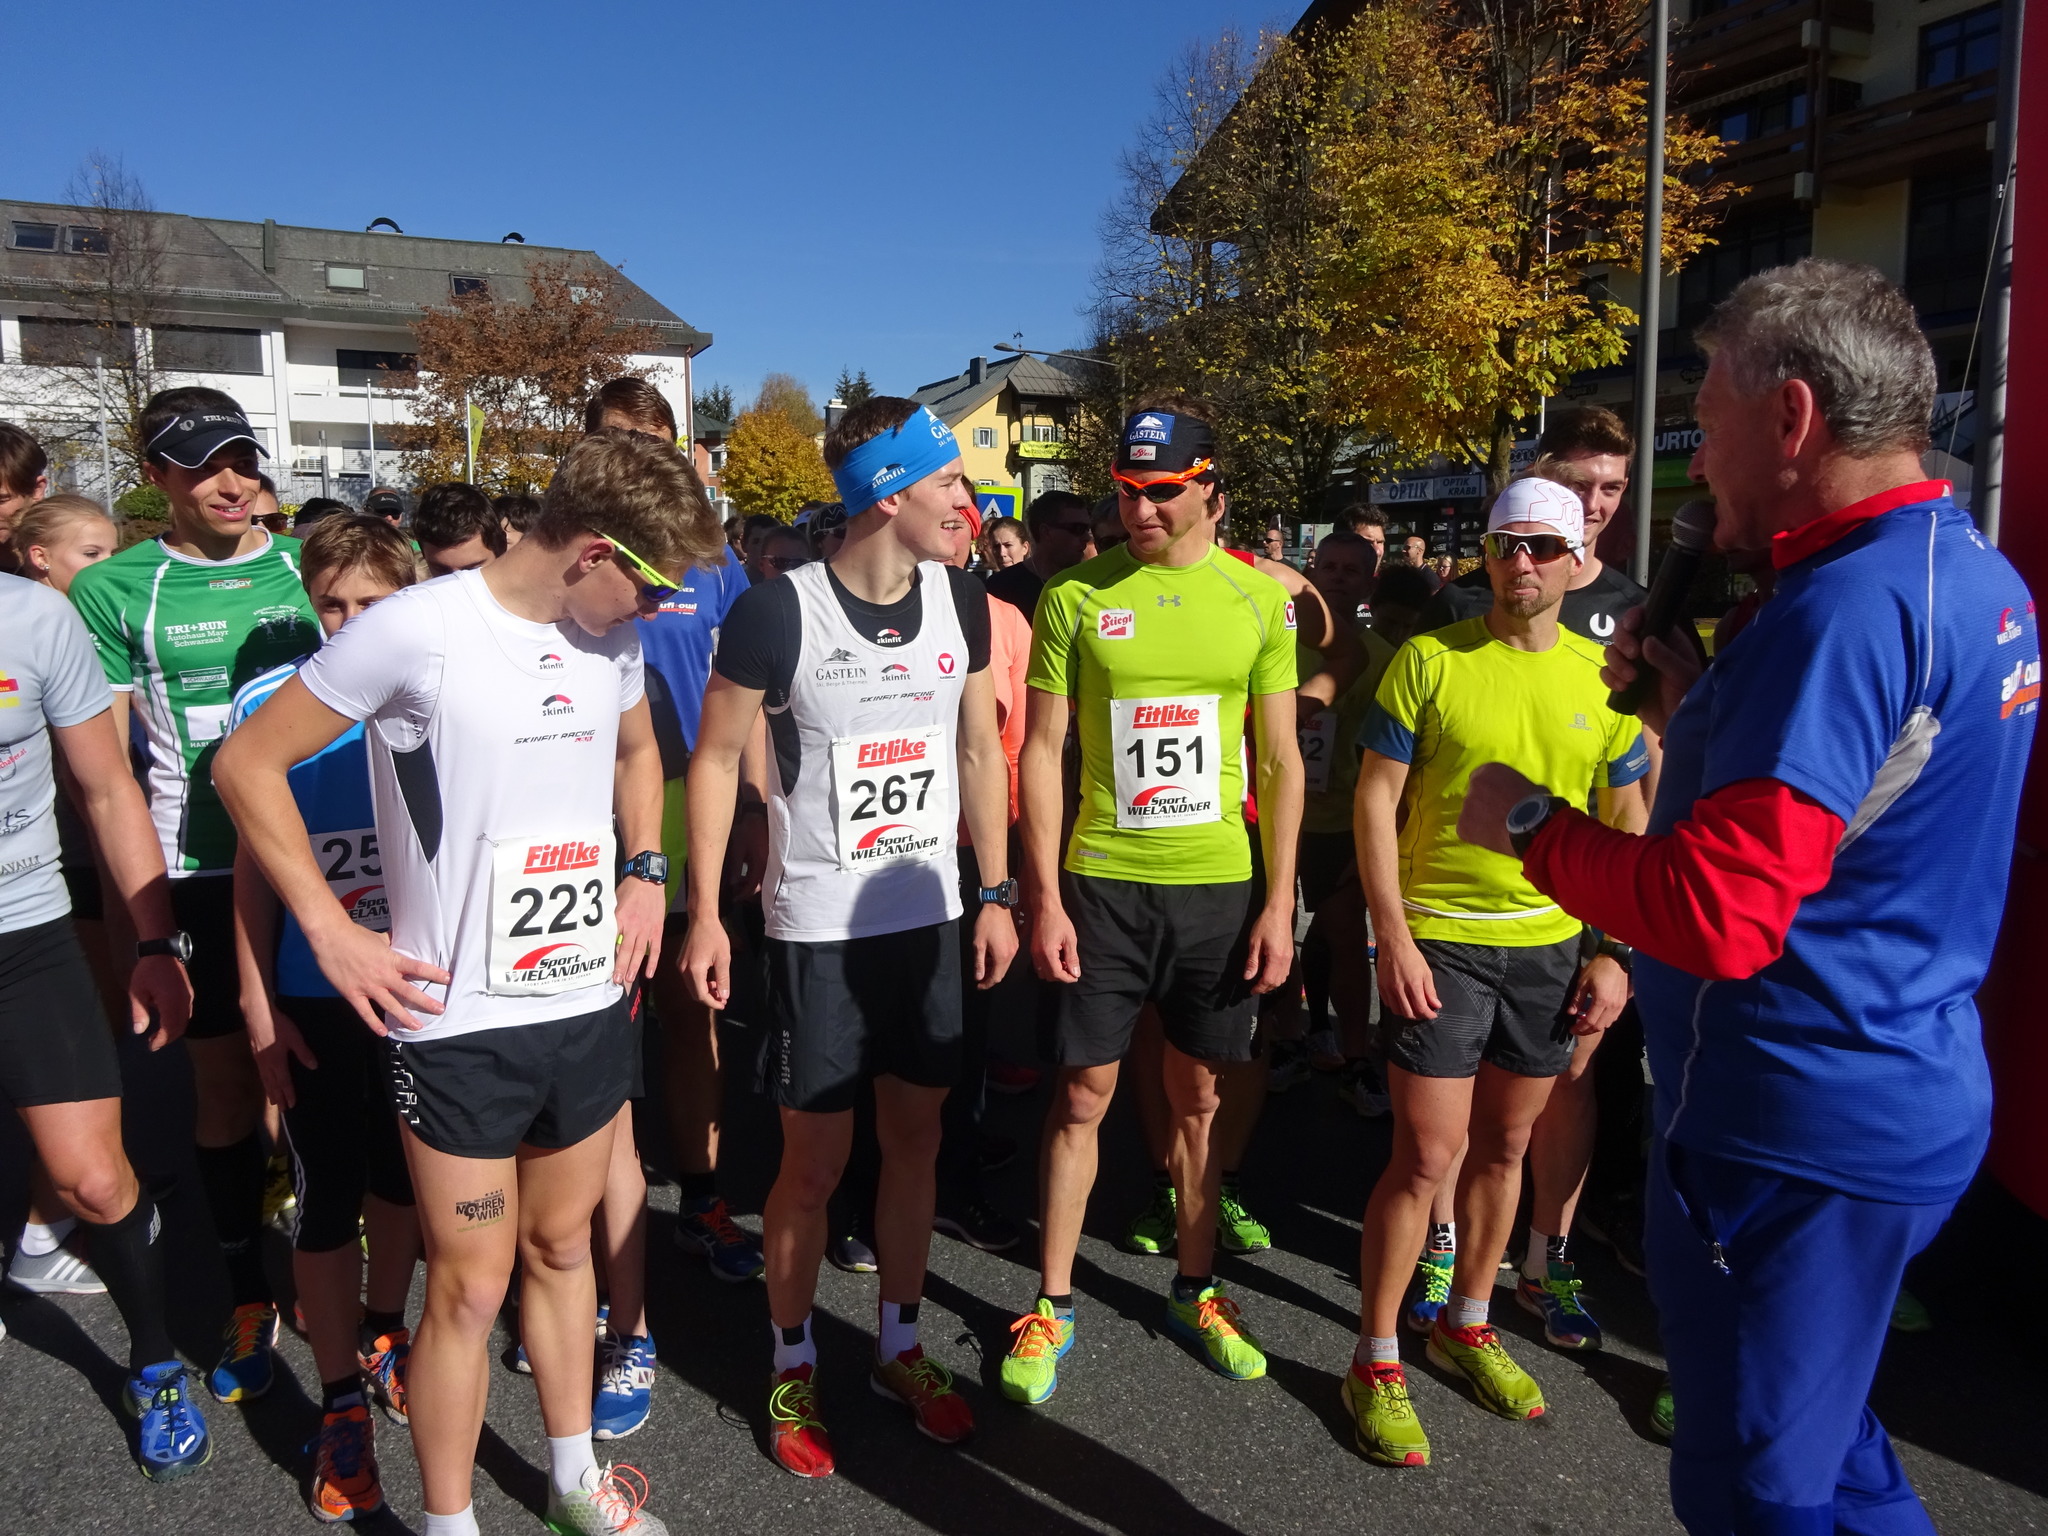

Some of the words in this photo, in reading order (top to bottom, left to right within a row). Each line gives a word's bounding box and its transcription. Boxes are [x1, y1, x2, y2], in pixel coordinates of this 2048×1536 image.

[1129, 429, 1167, 441] GASTEIN
[872, 466, 906, 489] skinfit
[1442, 477, 1470, 487] OPTIK
[1389, 482, 1429, 501] OPTIK
[1447, 486, 1477, 496] KRABB
[164, 620, 228, 635] TRI+RUN
[1101, 613, 1132, 631] Stiegl
[166, 632, 206, 642] Autohaus
[207, 629, 229, 638] Mayr
[174, 636, 224, 648] Schwarzach
[877, 636, 902, 644] skinfit
[539, 662, 564, 670] skinfit
[816, 667, 867, 681] GASTEIN
[881, 673, 911, 682] skinfit
[859, 693, 898, 703] SKINFIT
[900, 690, 935, 699] RACING
[542, 705, 575, 717] skinfit
[1133, 704, 1200, 729] FitLike
[514, 734, 558, 744] SKINFIT
[560, 729, 596, 740] RACING
[857, 738, 927, 769] FitLike
[1126, 735, 1203, 778] 151
[850, 769, 935, 821] 267
[1151, 795, 1187, 807] Sport
[1127, 801, 1211, 816] WIELANDNER
[850, 836, 938, 861] WIELANDNER
[876, 834, 914, 848] Sport
[524, 841, 600, 874] FitLike
[508, 878, 603, 938] 223
[538, 953, 581, 970] Sport
[505, 956, 607, 983] WIELANDNER
[476, 1205, 505, 1221] WIRT
